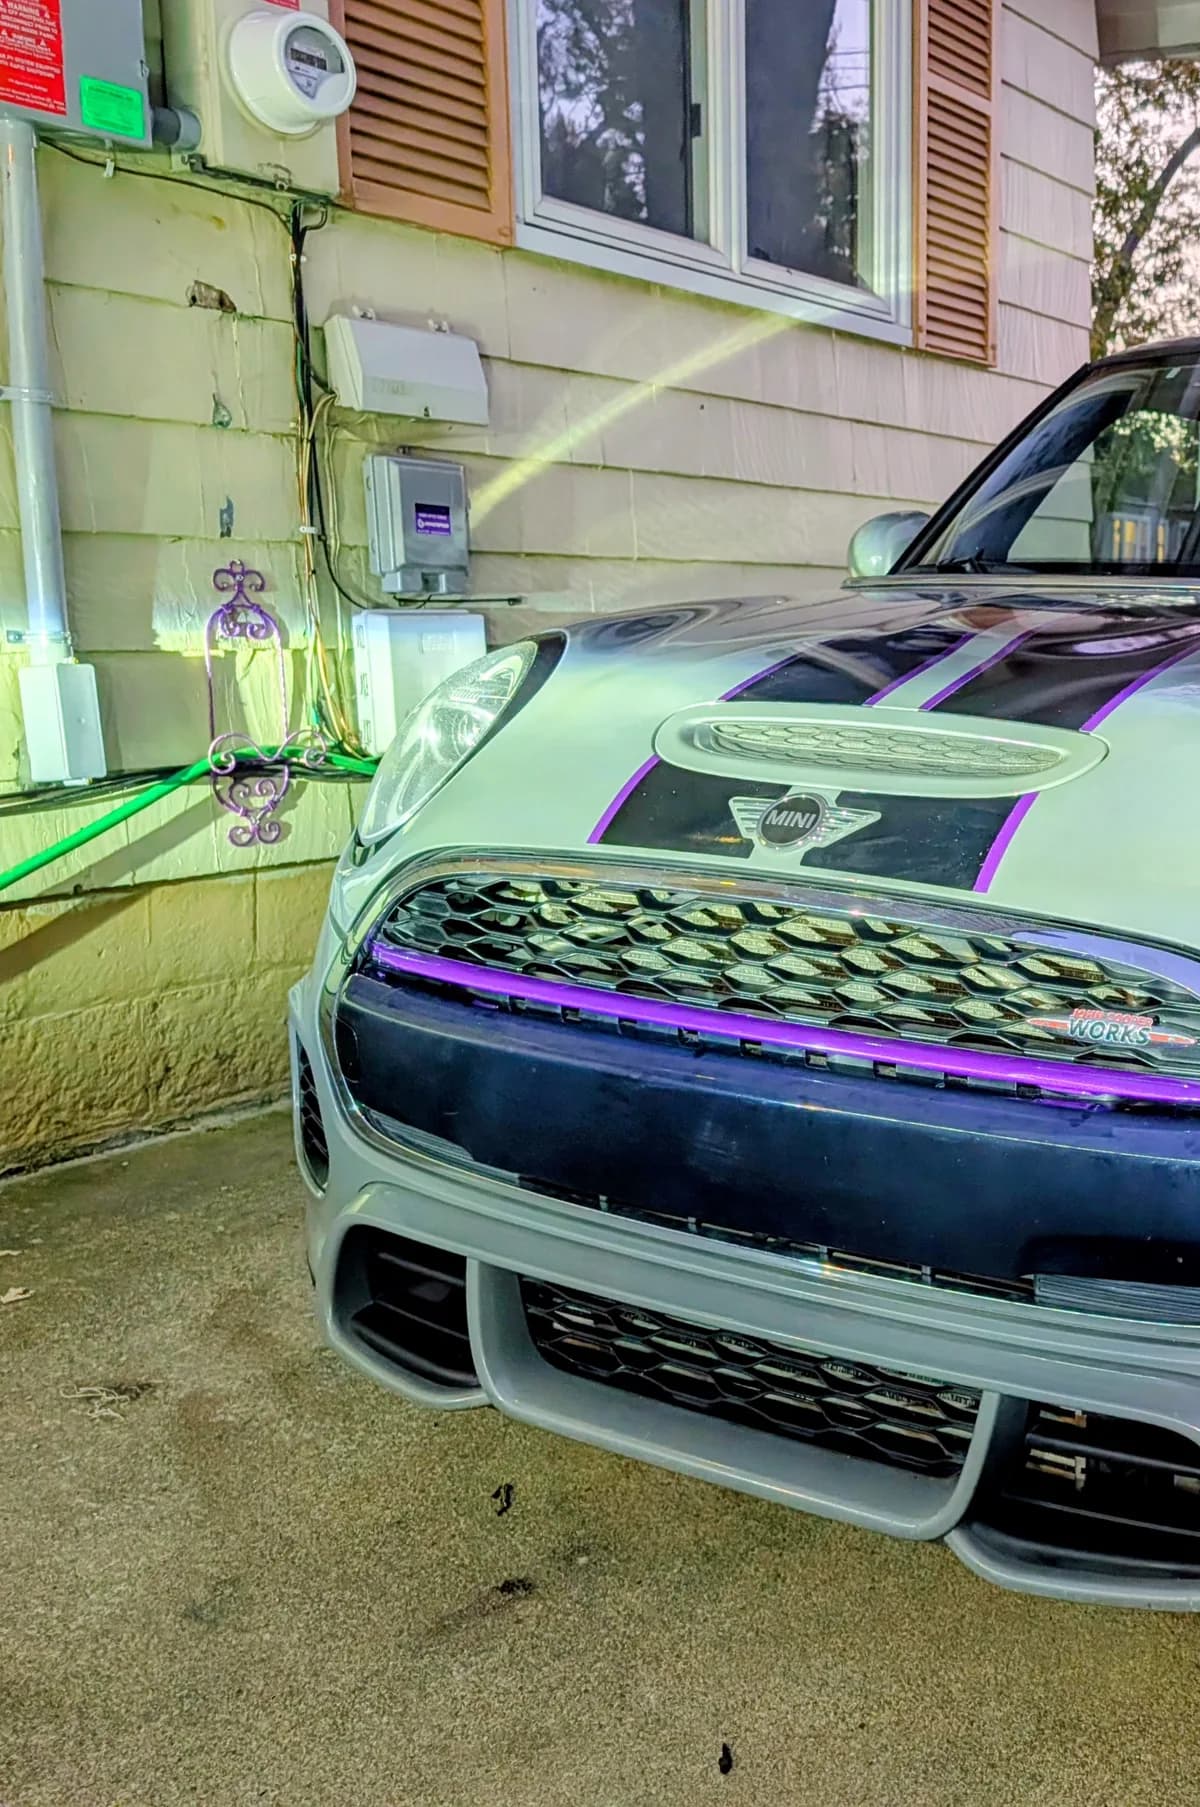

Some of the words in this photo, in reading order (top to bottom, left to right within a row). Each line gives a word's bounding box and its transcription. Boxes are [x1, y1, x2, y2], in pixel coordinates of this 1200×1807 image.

[765, 809, 817, 829] MINI
[1106, 1012, 1153, 1026] COOPER
[1069, 1018, 1152, 1046] WORKS
